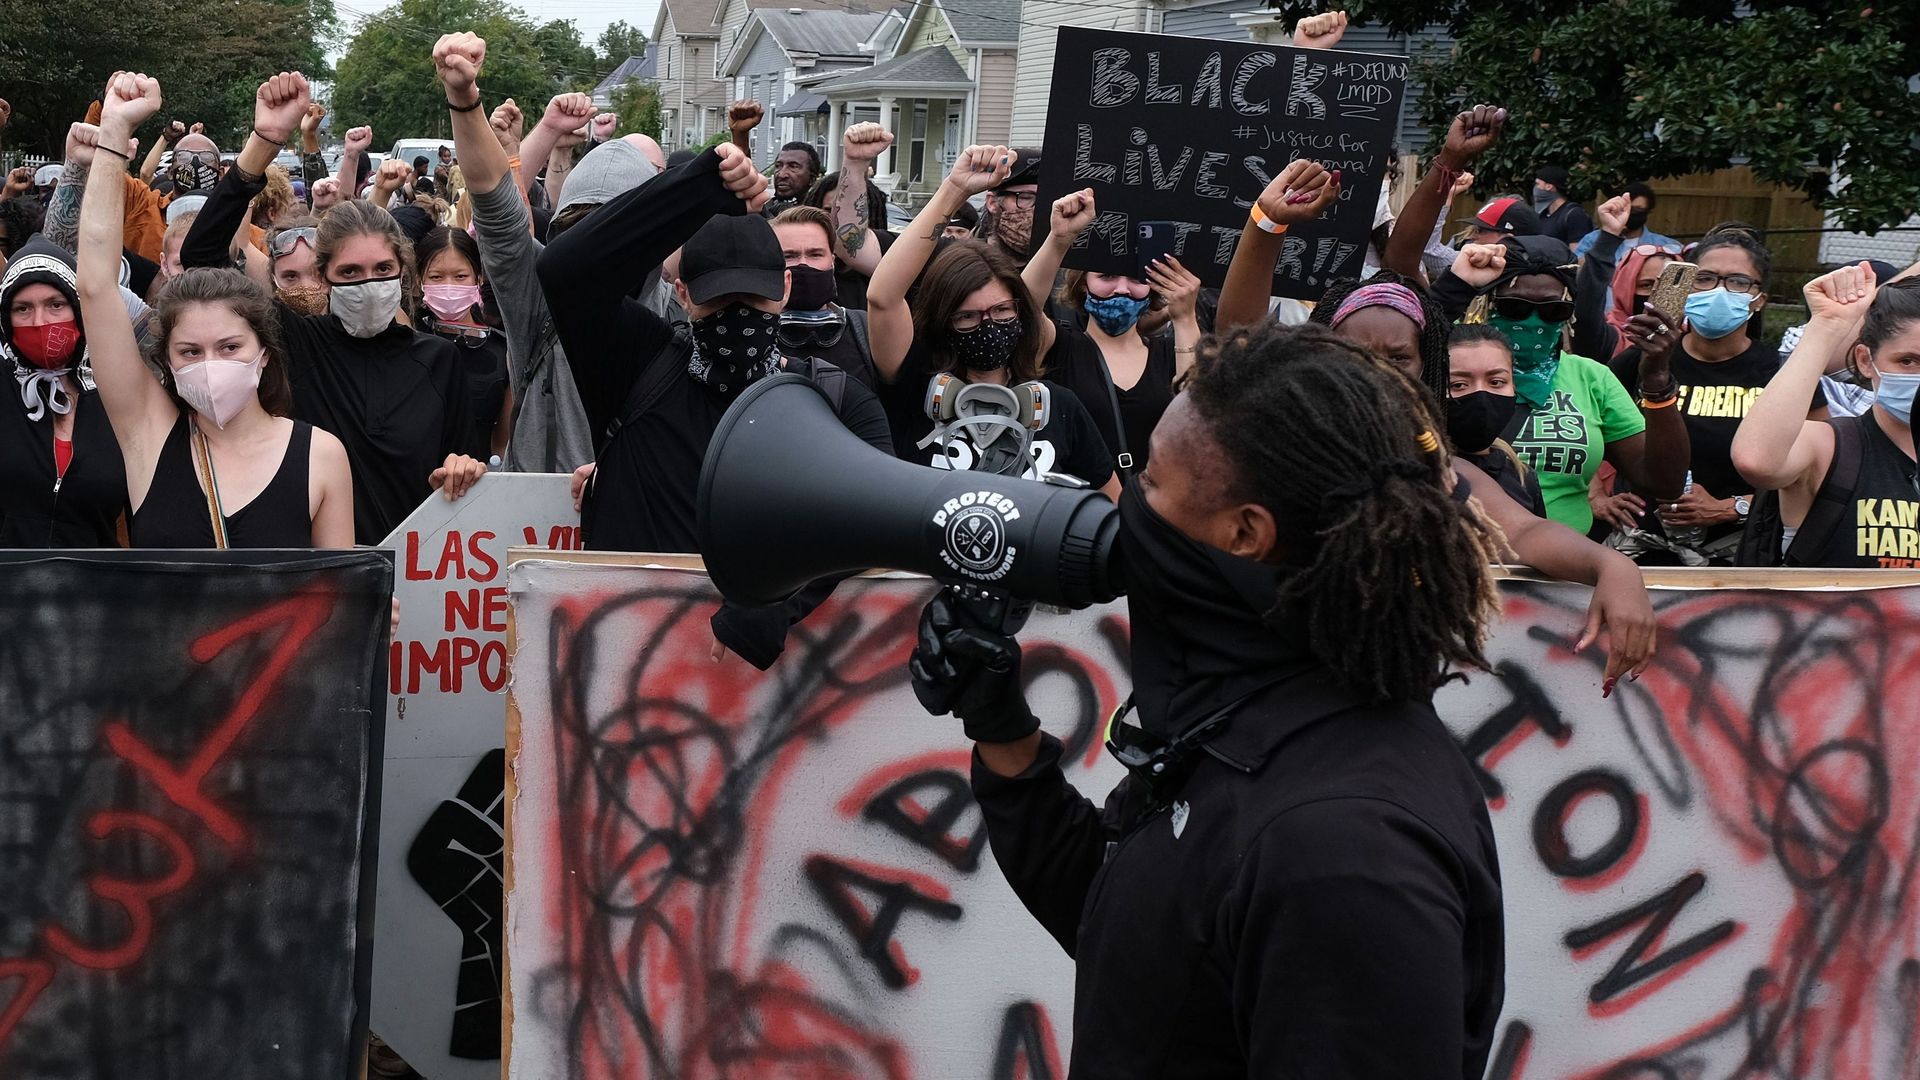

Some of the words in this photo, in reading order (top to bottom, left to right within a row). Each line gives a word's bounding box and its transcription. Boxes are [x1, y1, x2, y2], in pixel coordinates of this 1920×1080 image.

[1090, 47, 1328, 120] BLACK
[1332, 62, 1409, 82] #DEFUND
[1337, 83, 1392, 105] LMPD
[24, 258, 41, 266] LOVE
[44, 259, 59, 270] LOVE
[1071, 210, 1359, 286] MTTR!!
[1687, 385, 1764, 418] BREATH
[932, 491, 1021, 528] PROTECT
[405, 530, 499, 583] LAS
[940, 549, 960, 571] THE
[960, 546, 1017, 581] PROTESTORS
[390, 637, 507, 695] IMPO
